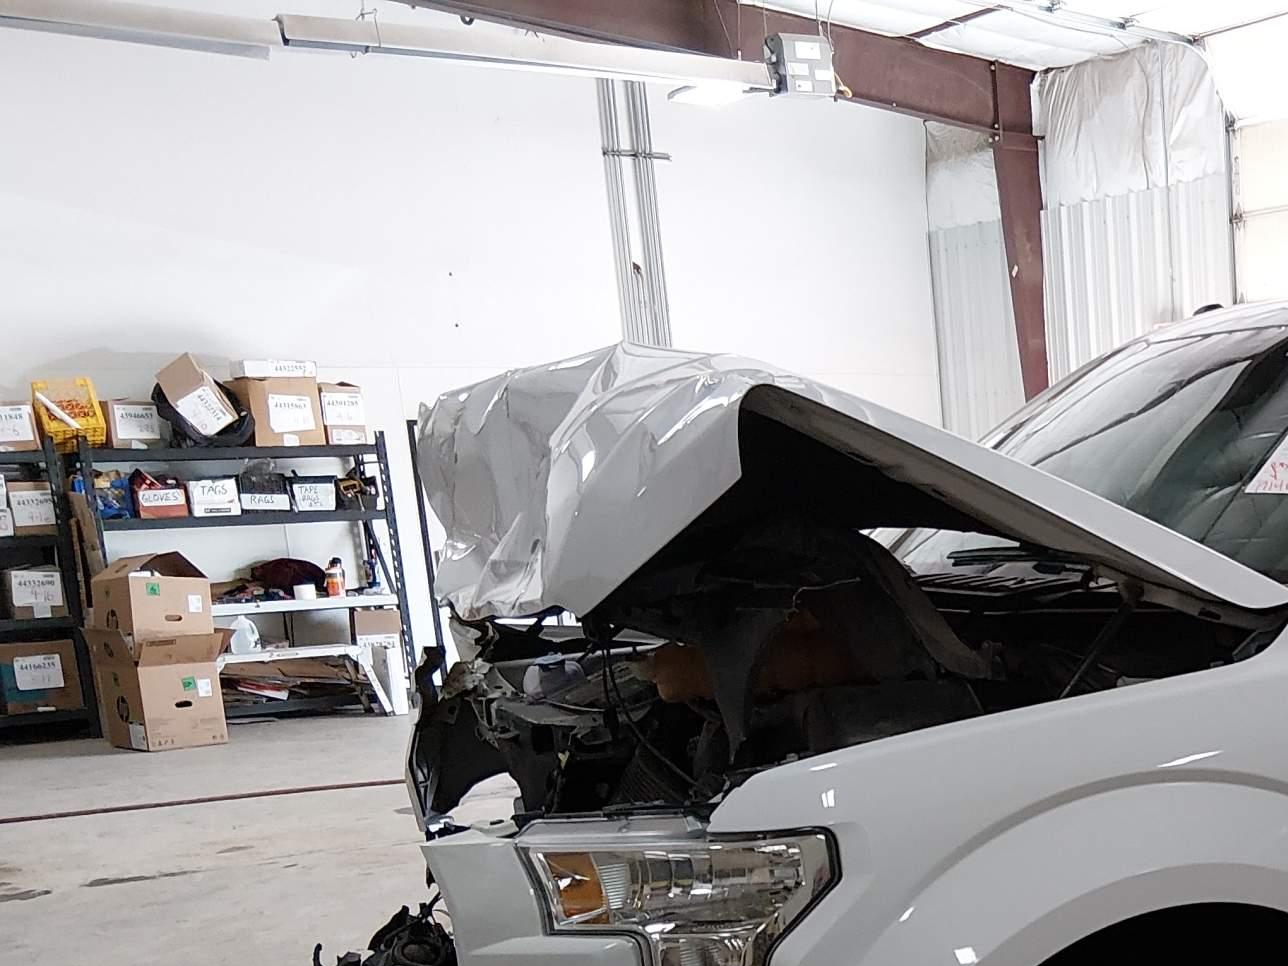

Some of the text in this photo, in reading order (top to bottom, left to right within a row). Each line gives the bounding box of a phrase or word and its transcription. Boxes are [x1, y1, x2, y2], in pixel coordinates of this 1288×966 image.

[200, 485, 228, 496] TAGS
[298, 485, 319, 494] TAPE
[141, 492, 179, 504] GLOVES
[250, 495, 275, 505] RAGS
